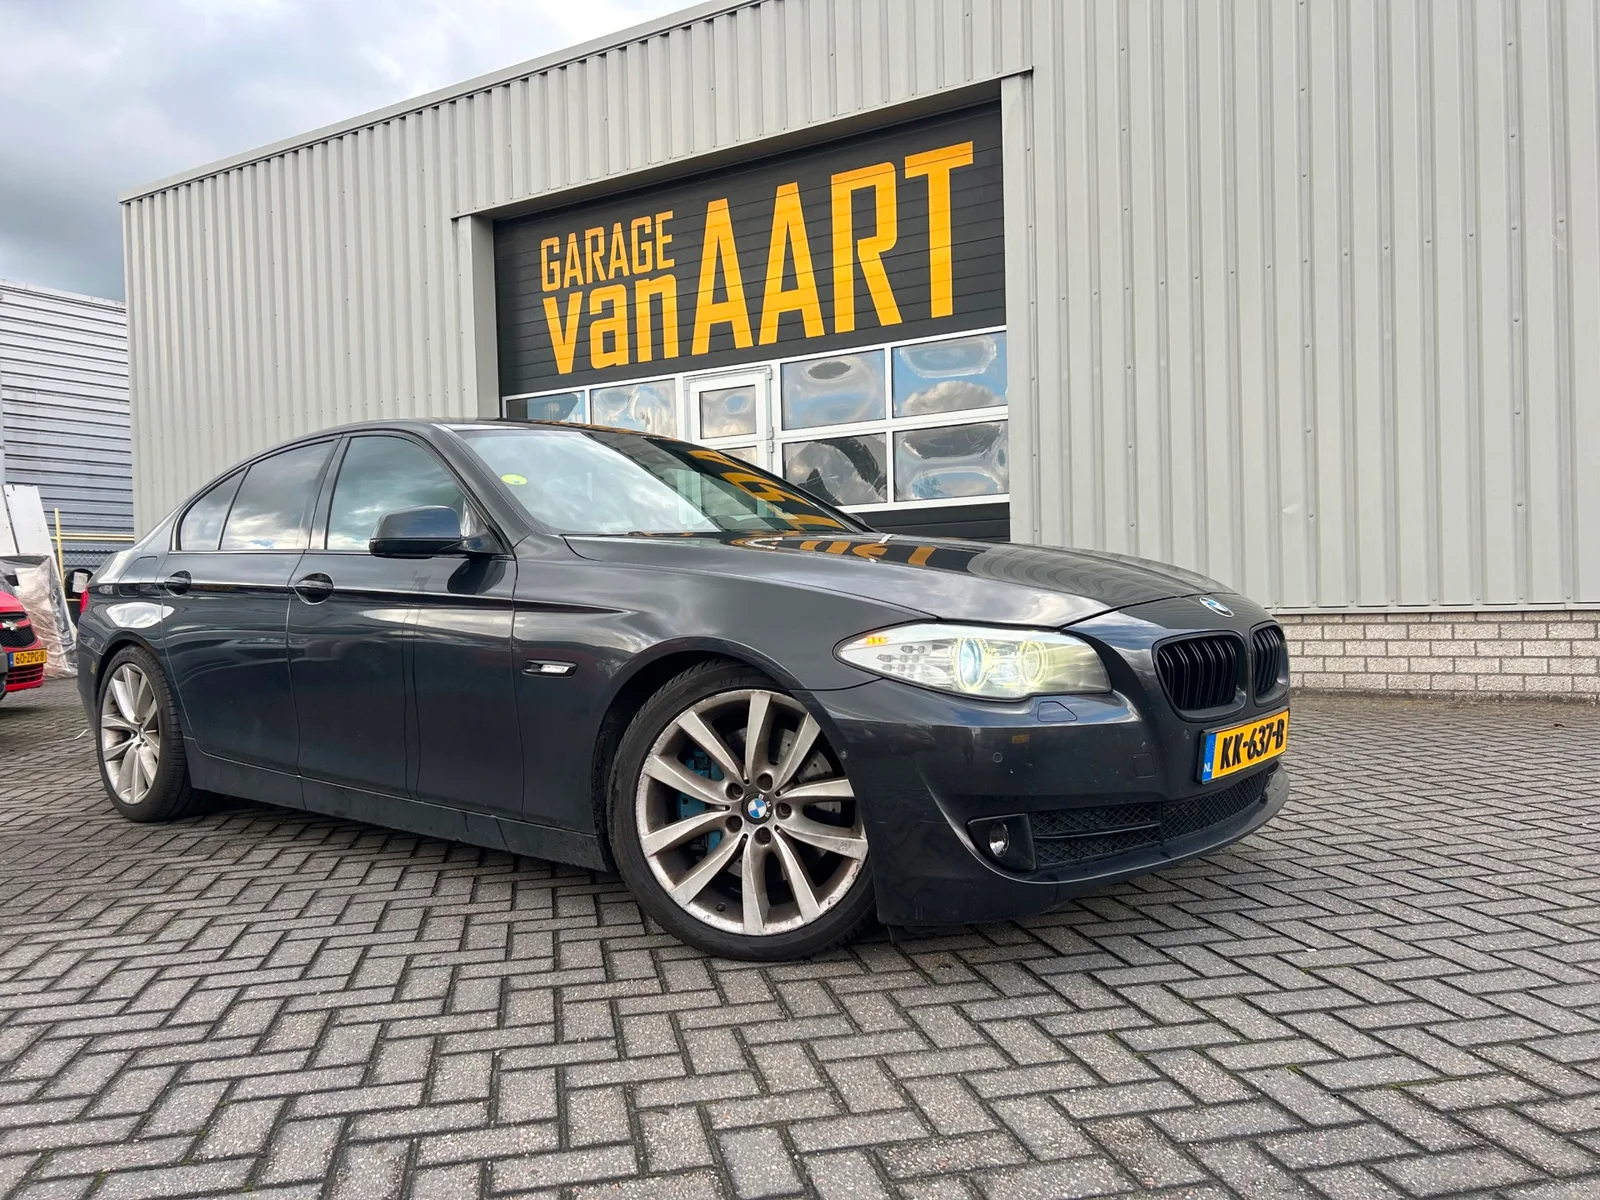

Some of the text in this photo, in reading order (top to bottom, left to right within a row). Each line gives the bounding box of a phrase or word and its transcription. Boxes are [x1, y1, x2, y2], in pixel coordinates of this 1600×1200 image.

[541, 210, 675, 292] GARAGE
[543, 140, 974, 375] van AART
[1203, 762, 1212, 773] NL
[1220, 718, 1285, 770] KK-637-B
